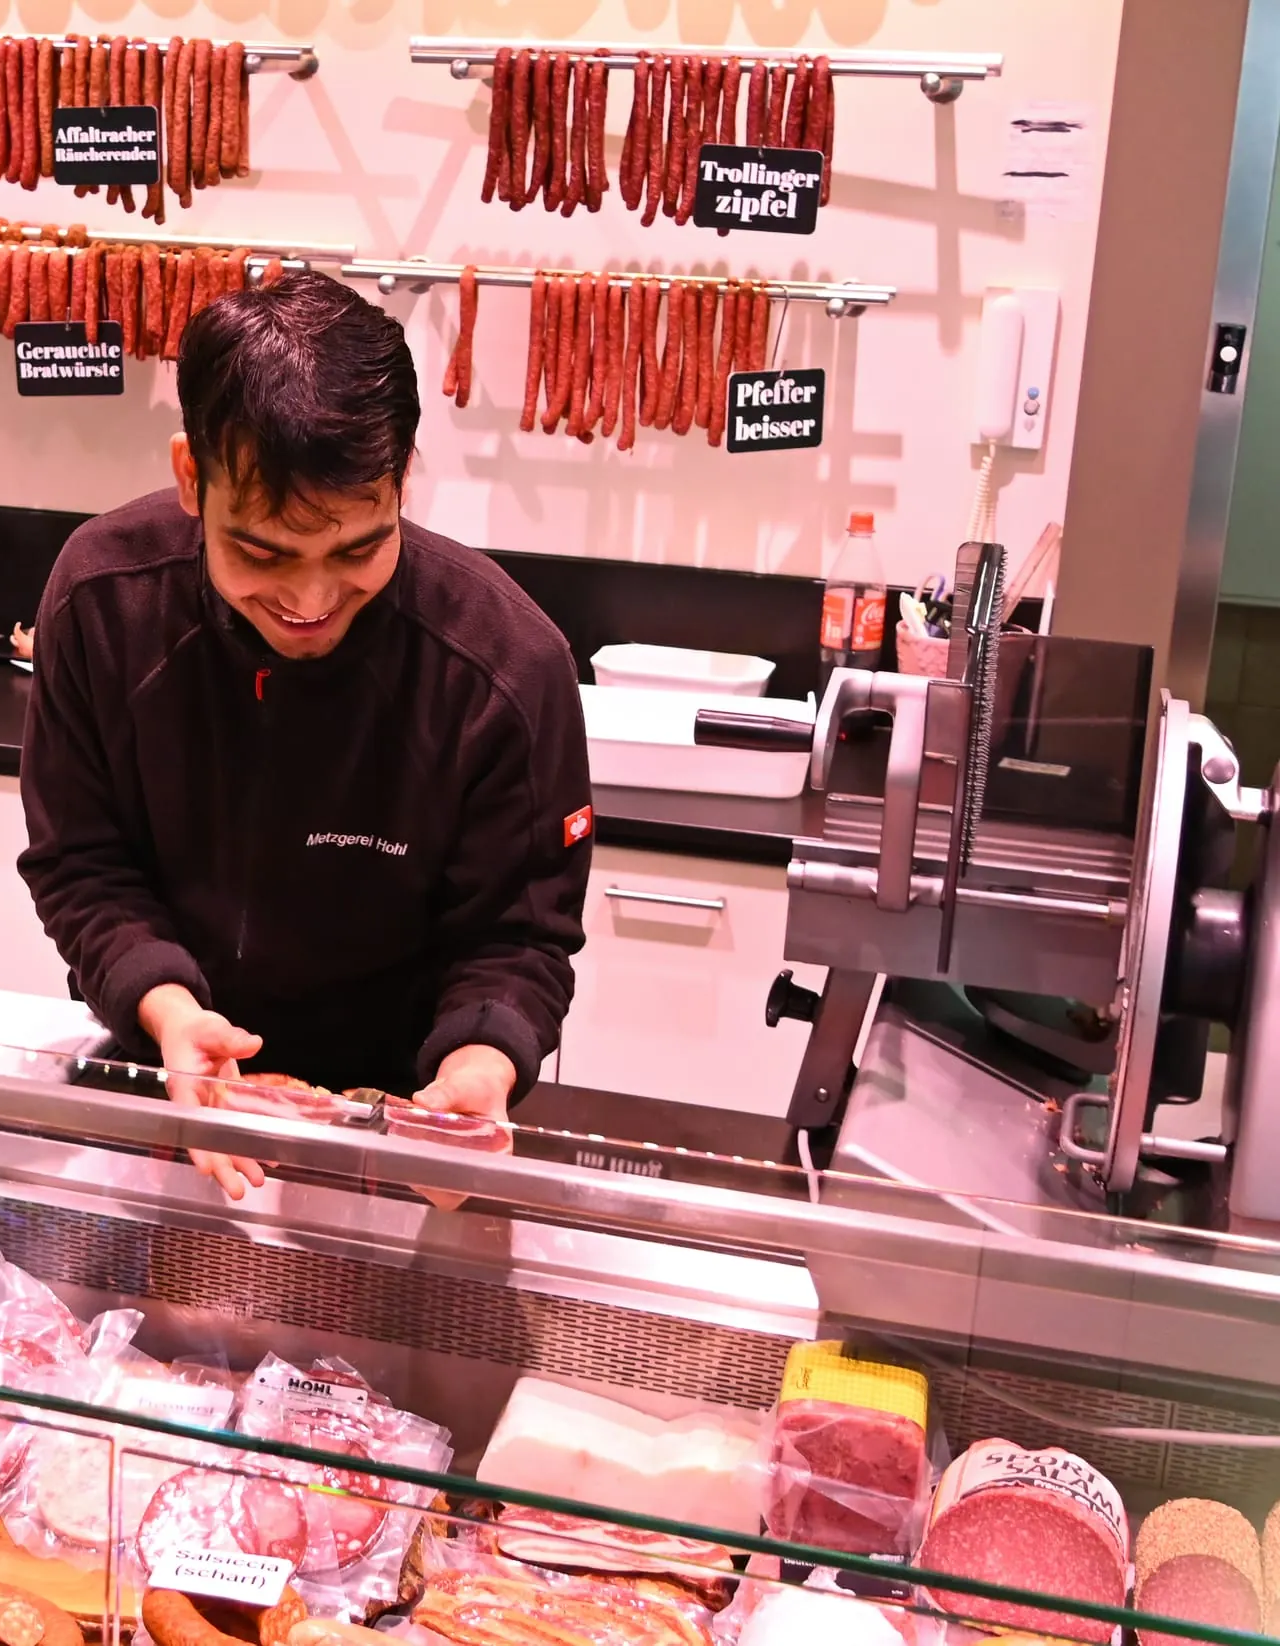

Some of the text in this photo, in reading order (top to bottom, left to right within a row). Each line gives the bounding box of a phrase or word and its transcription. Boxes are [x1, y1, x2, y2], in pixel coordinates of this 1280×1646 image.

[55, 125, 156, 144] Affaltracher
[55, 146, 157, 162] Räucherenden
[700, 160, 820, 192] Trollinger
[715, 188, 797, 222] zipfel
[16, 341, 121, 360] Gerauchte
[20, 362, 120, 379] Bratwürste
[736, 378, 817, 407] Pfeffer
[735, 415, 816, 441] beisser
[306, 831, 409, 856] Metzgerei Hohl
[288, 1377, 333, 1396] HOHL
[982, 1452, 1102, 1485] SPORT
[1001, 1463, 1122, 1528] SALAMI
[175, 1549, 279, 1573] Salsiccia
[175, 1564, 266, 1589] (scharf)
